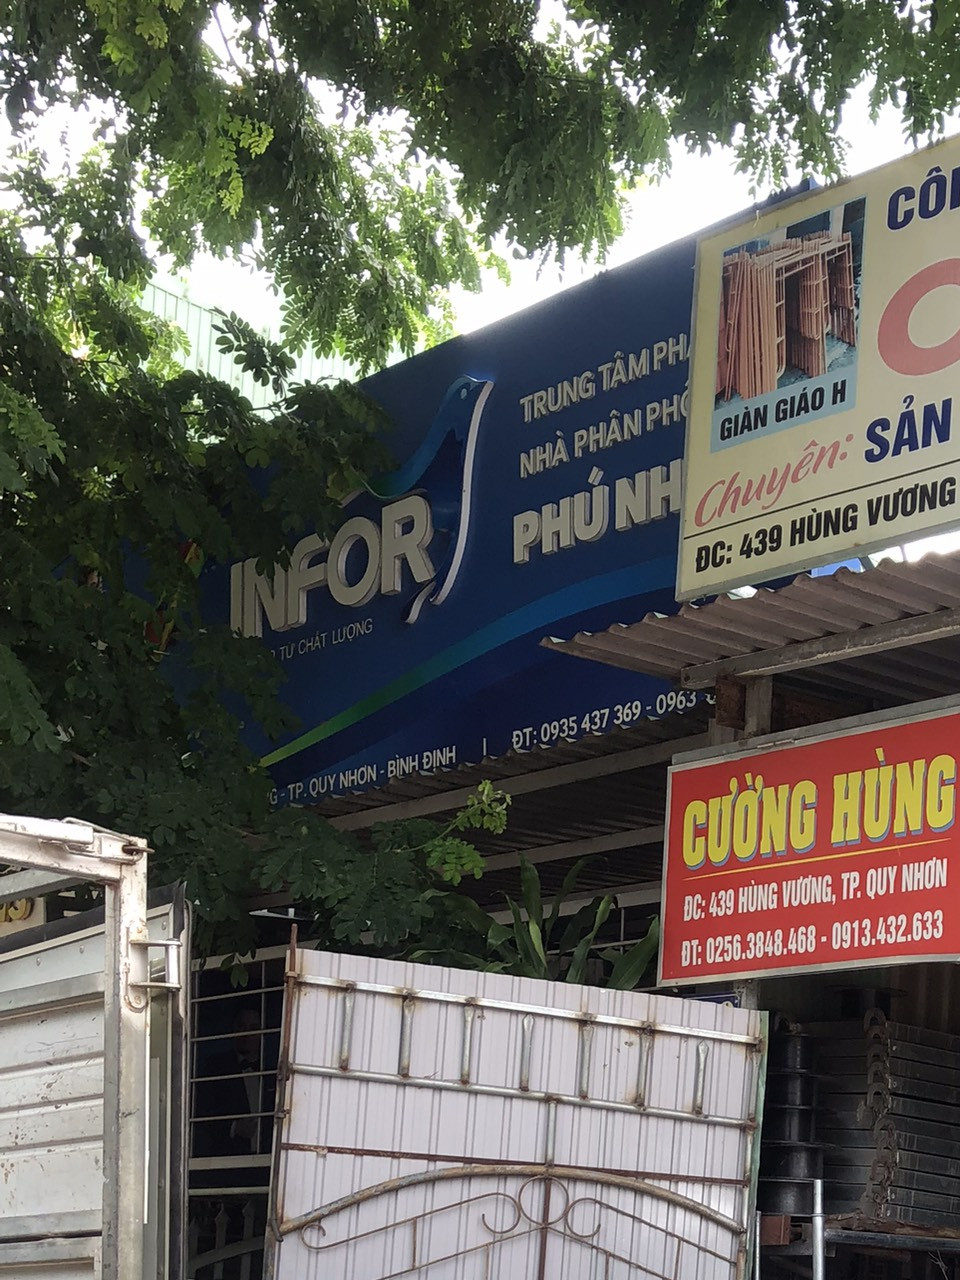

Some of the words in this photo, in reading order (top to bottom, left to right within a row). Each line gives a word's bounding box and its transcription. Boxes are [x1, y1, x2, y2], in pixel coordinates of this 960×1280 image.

[520, 371, 595, 422] TRUNG
[598, 348, 649, 391] TÂM
[654, 333, 691, 371] PH
[719, 404, 768, 441] GIÀN
[775, 386, 824, 423] GIÁO
[832, 380, 847, 405] H
[520, 430, 569, 478] NHÀ
[574, 408, 641, 457] PHÂN
[694, 433, 854, 527] Chuyên:
[865, 395, 952, 463] SẢN
[513, 466, 610, 564] PHÚ
[695, 541, 733, 573] ĐC:
[740, 525, 782, 559] 439
[790, 508, 858, 547] HÙNG
[867, 477, 956, 525] VƯƠNG
[332, 618, 373, 645] LƯỢNG
[288, 782, 307, 801] TP.
[309, 774, 336, 796] QUY
[339, 764, 377, 790] NHƠN
[387, 749, 418, 778] BÌNH
[423, 745, 456, 771] ĐỊNH
[512, 727, 538, 749] ĐT:
[540, 716, 577, 743] 0935
[580, 708, 610, 733] 437
[613, 700, 642, 726] 369
[683, 772, 818, 870] CƯỜNG
[831, 747, 956, 847] HÙNG
[683, 894, 706, 922] ĐC:
[709, 889, 734, 917] 439
[738, 880, 778, 914] HÙNG
[782, 875, 836, 905] VƯƠNG,
[841, 872, 861, 900] TP.
[866, 866, 898, 898] QUY
[901, 857, 948, 892] NHƠN
[681, 940, 702, 967] ĐT:
[706, 925, 816, 963] 0256.3848.468
[832, 909, 944, 950] 0913.432.633
